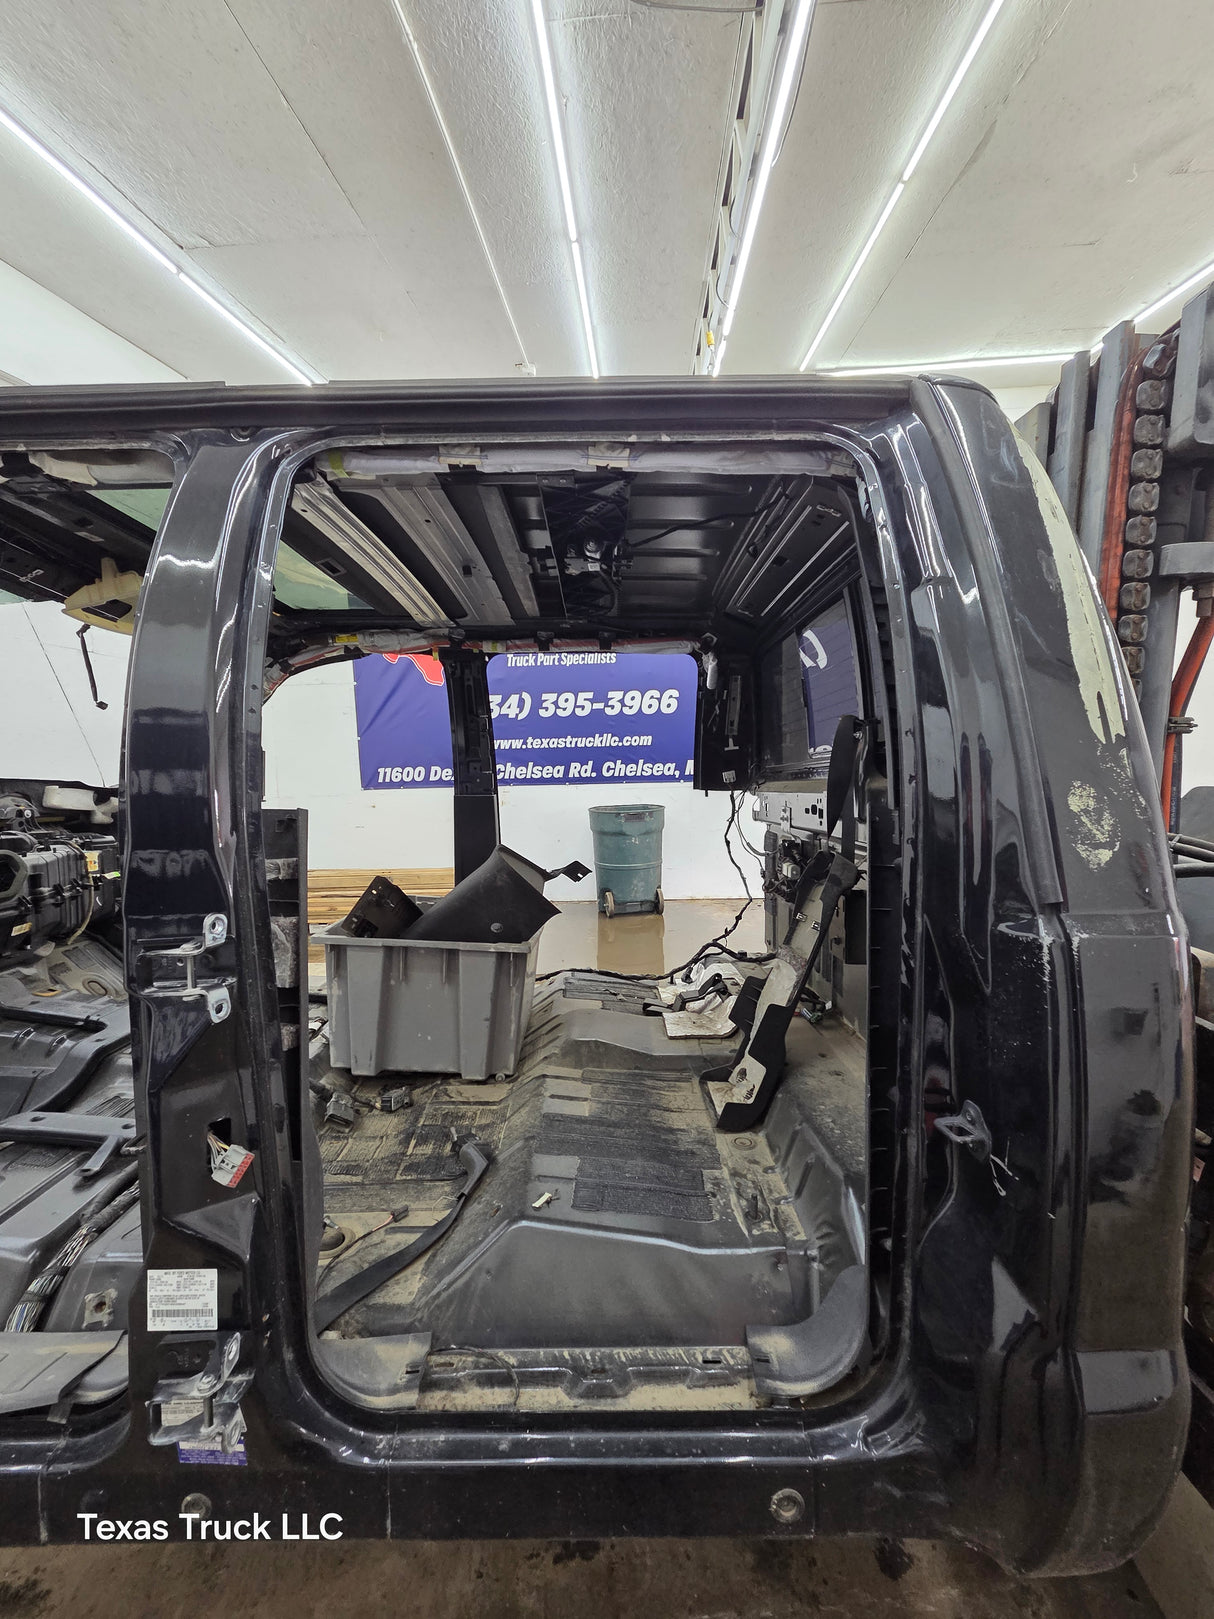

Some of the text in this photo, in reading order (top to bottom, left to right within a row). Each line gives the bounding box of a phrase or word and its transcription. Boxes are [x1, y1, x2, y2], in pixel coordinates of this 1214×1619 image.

[506, 653, 617, 667] Truck Part Specialists
[538, 689, 680, 718] 395-3966
[377, 766, 426, 783] 11600
[429, 766, 455, 782] De
[496, 761, 565, 780] Chelsea
[568, 760, 597, 778] Rd.
[602, 759, 680, 779] Chelsea,
